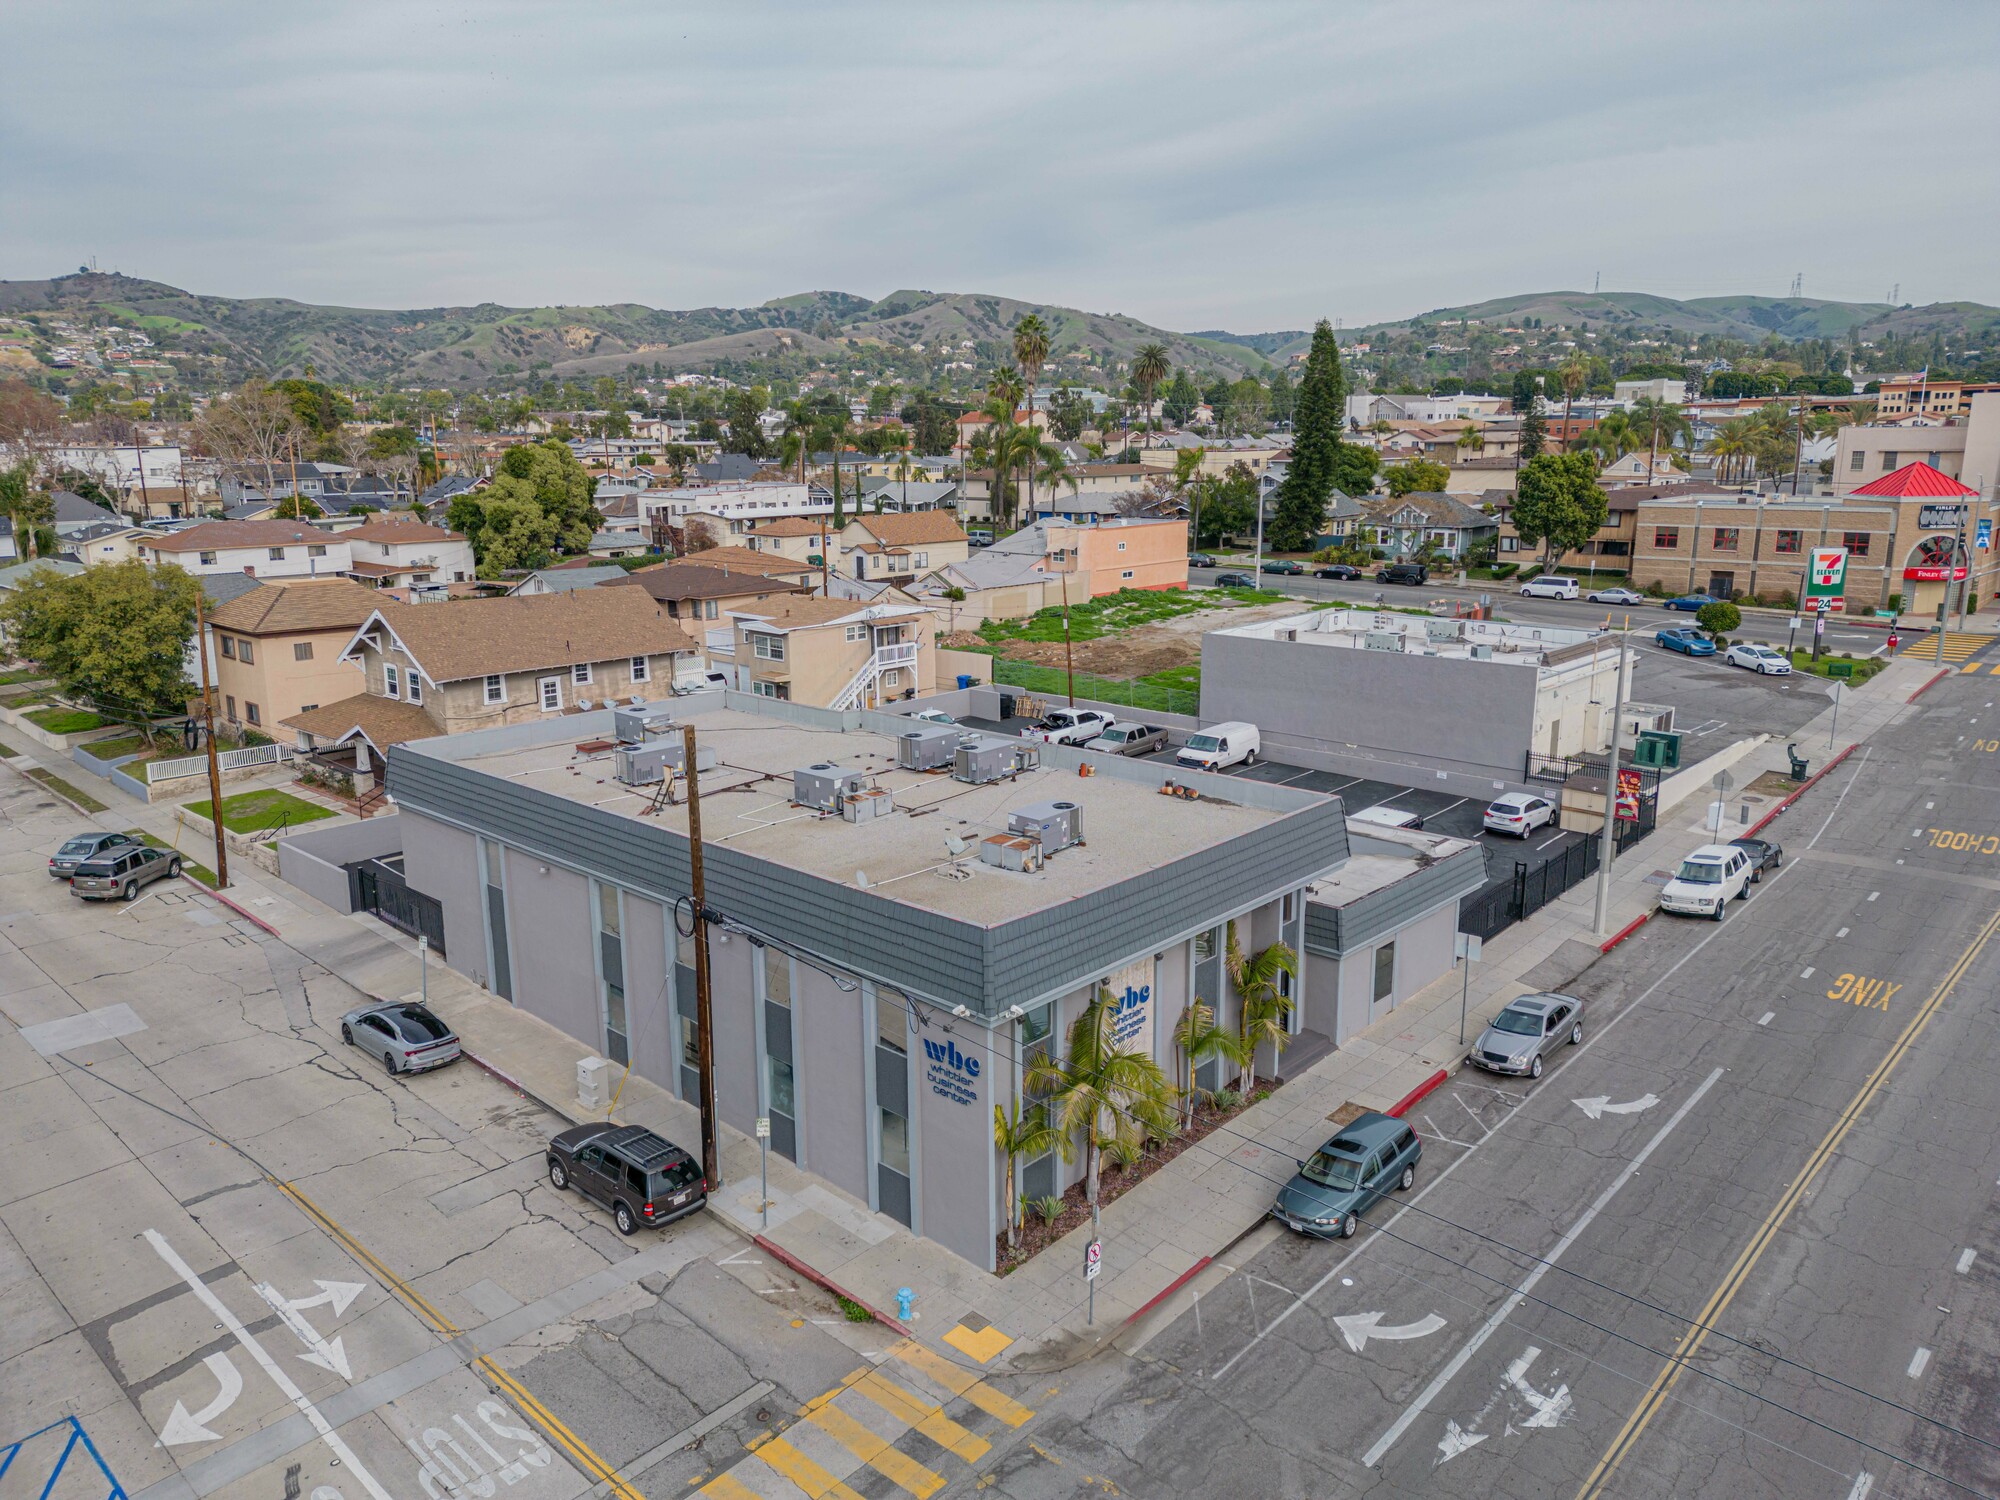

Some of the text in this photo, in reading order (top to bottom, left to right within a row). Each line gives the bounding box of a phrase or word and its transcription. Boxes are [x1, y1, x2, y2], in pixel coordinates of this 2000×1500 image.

[1819, 554, 1842, 584] 7
[1818, 599, 1831, 609] 24
[1928, 828, 2000, 855] CHOOL
[1827, 973, 1902, 1011] XING
[923, 1038, 980, 1077] wbc
[927, 1071, 977, 1100] business
[930, 1063, 974, 1087] whittier
[933, 1085, 972, 1106] center
[406, 1401, 551, 1500] STOP
